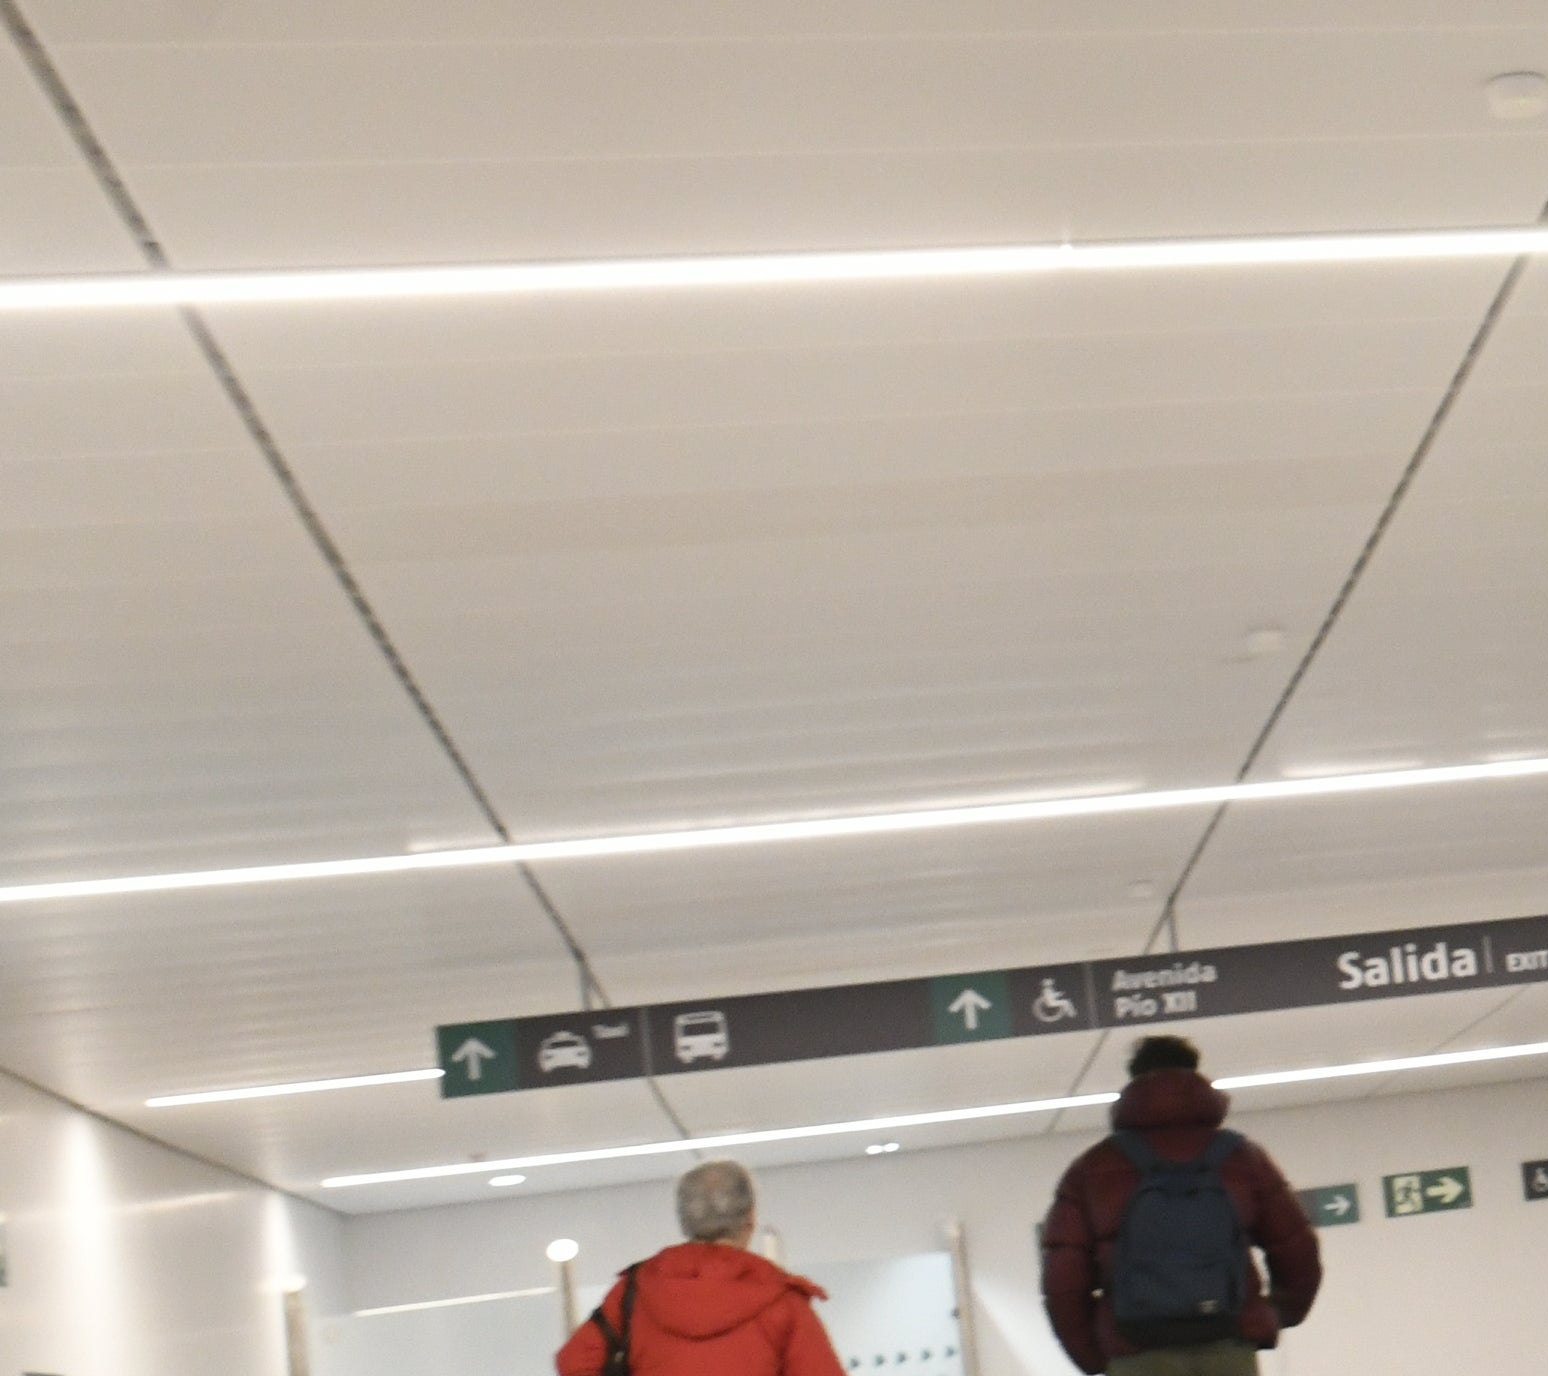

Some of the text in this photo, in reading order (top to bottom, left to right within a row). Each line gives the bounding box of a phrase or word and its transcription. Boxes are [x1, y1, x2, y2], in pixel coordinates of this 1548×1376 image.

[1112, 960, 1219, 991] Avenida
[1337, 942, 1478, 989] Salida
[1114, 993, 1159, 1019] Pío
